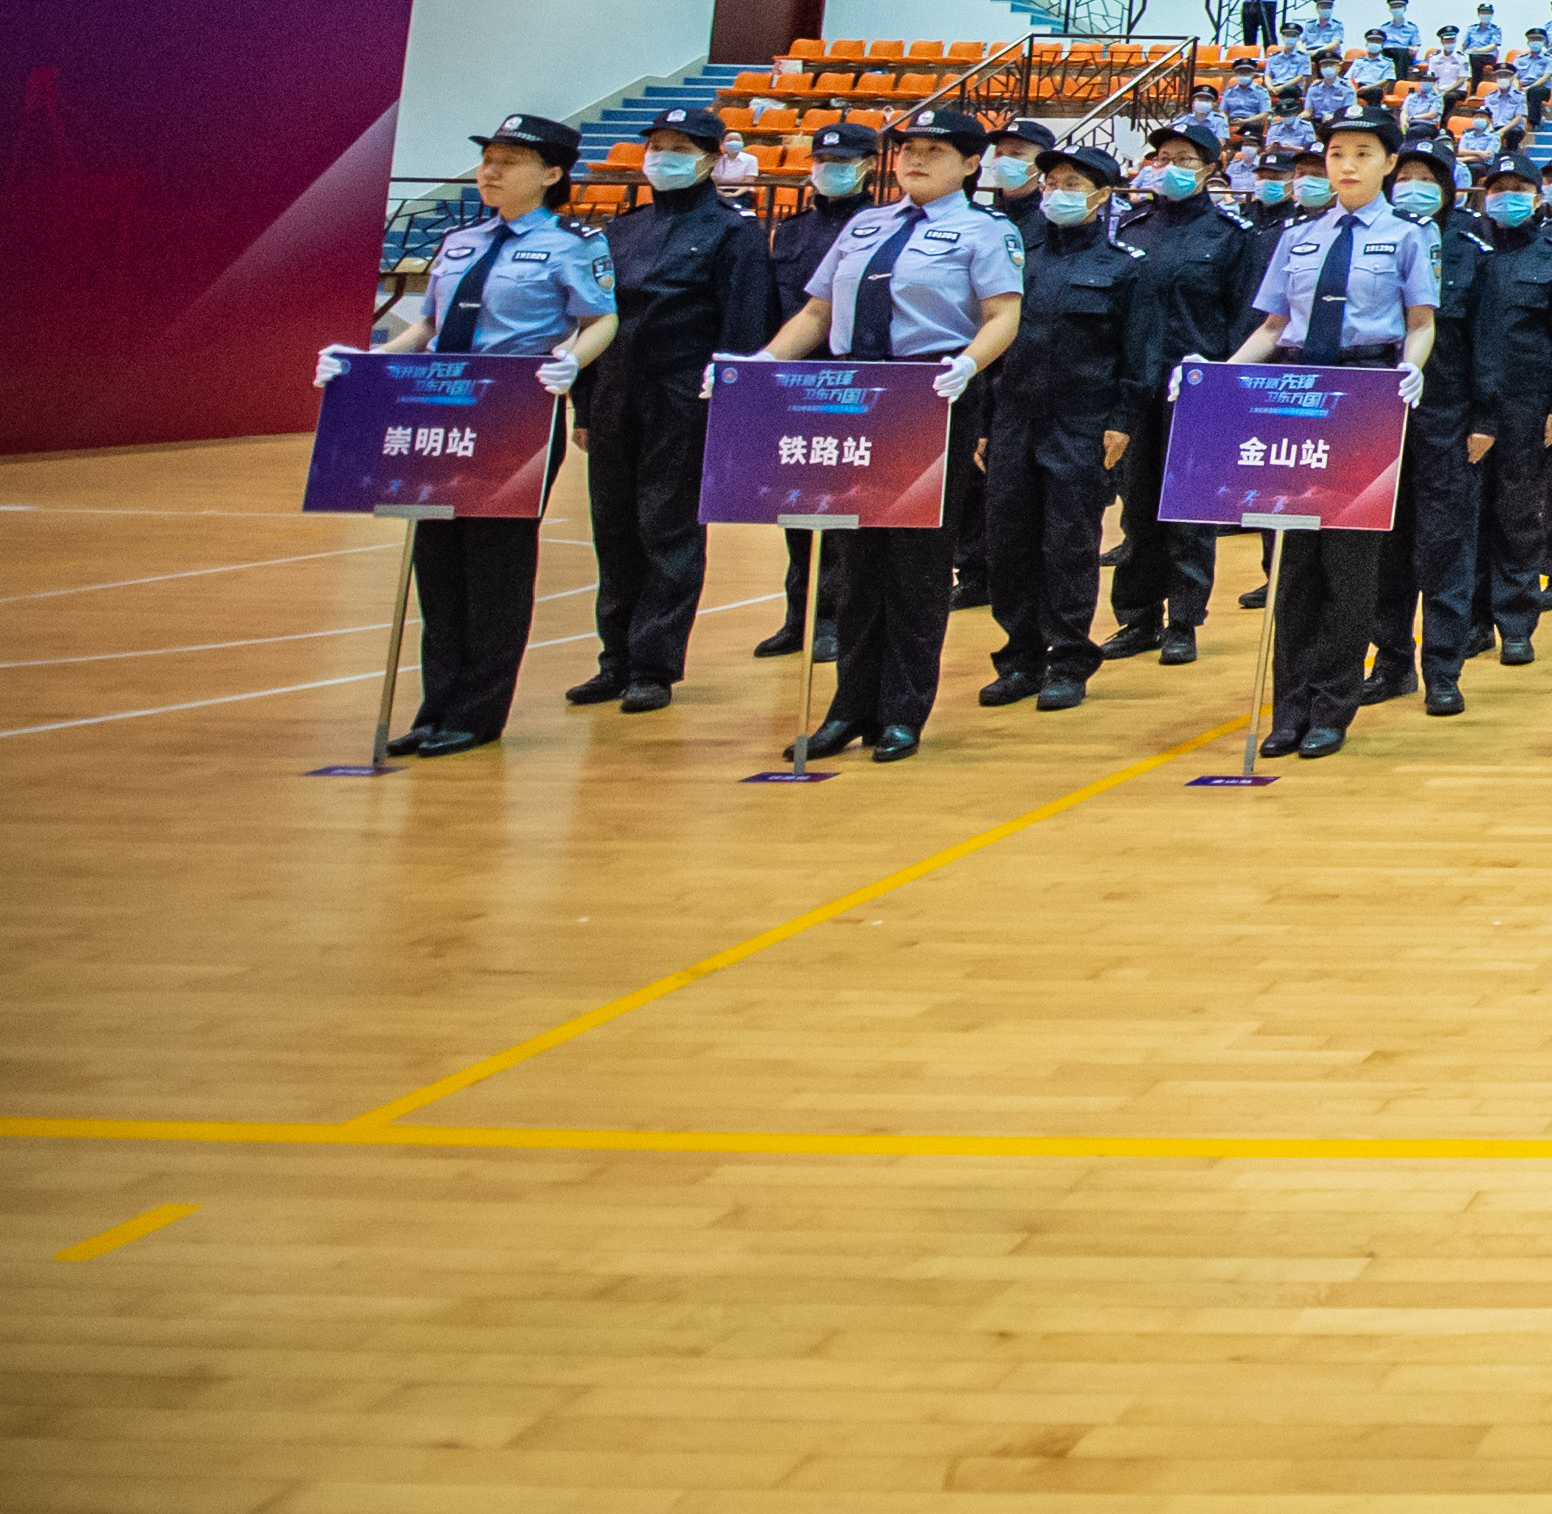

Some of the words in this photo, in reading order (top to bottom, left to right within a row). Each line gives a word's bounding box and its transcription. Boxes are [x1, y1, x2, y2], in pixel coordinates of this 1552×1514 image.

[383, 427, 476, 457] 崇明站
[779, 435, 872, 467] 铁路站
[1238, 437, 1330, 469] 金山站
